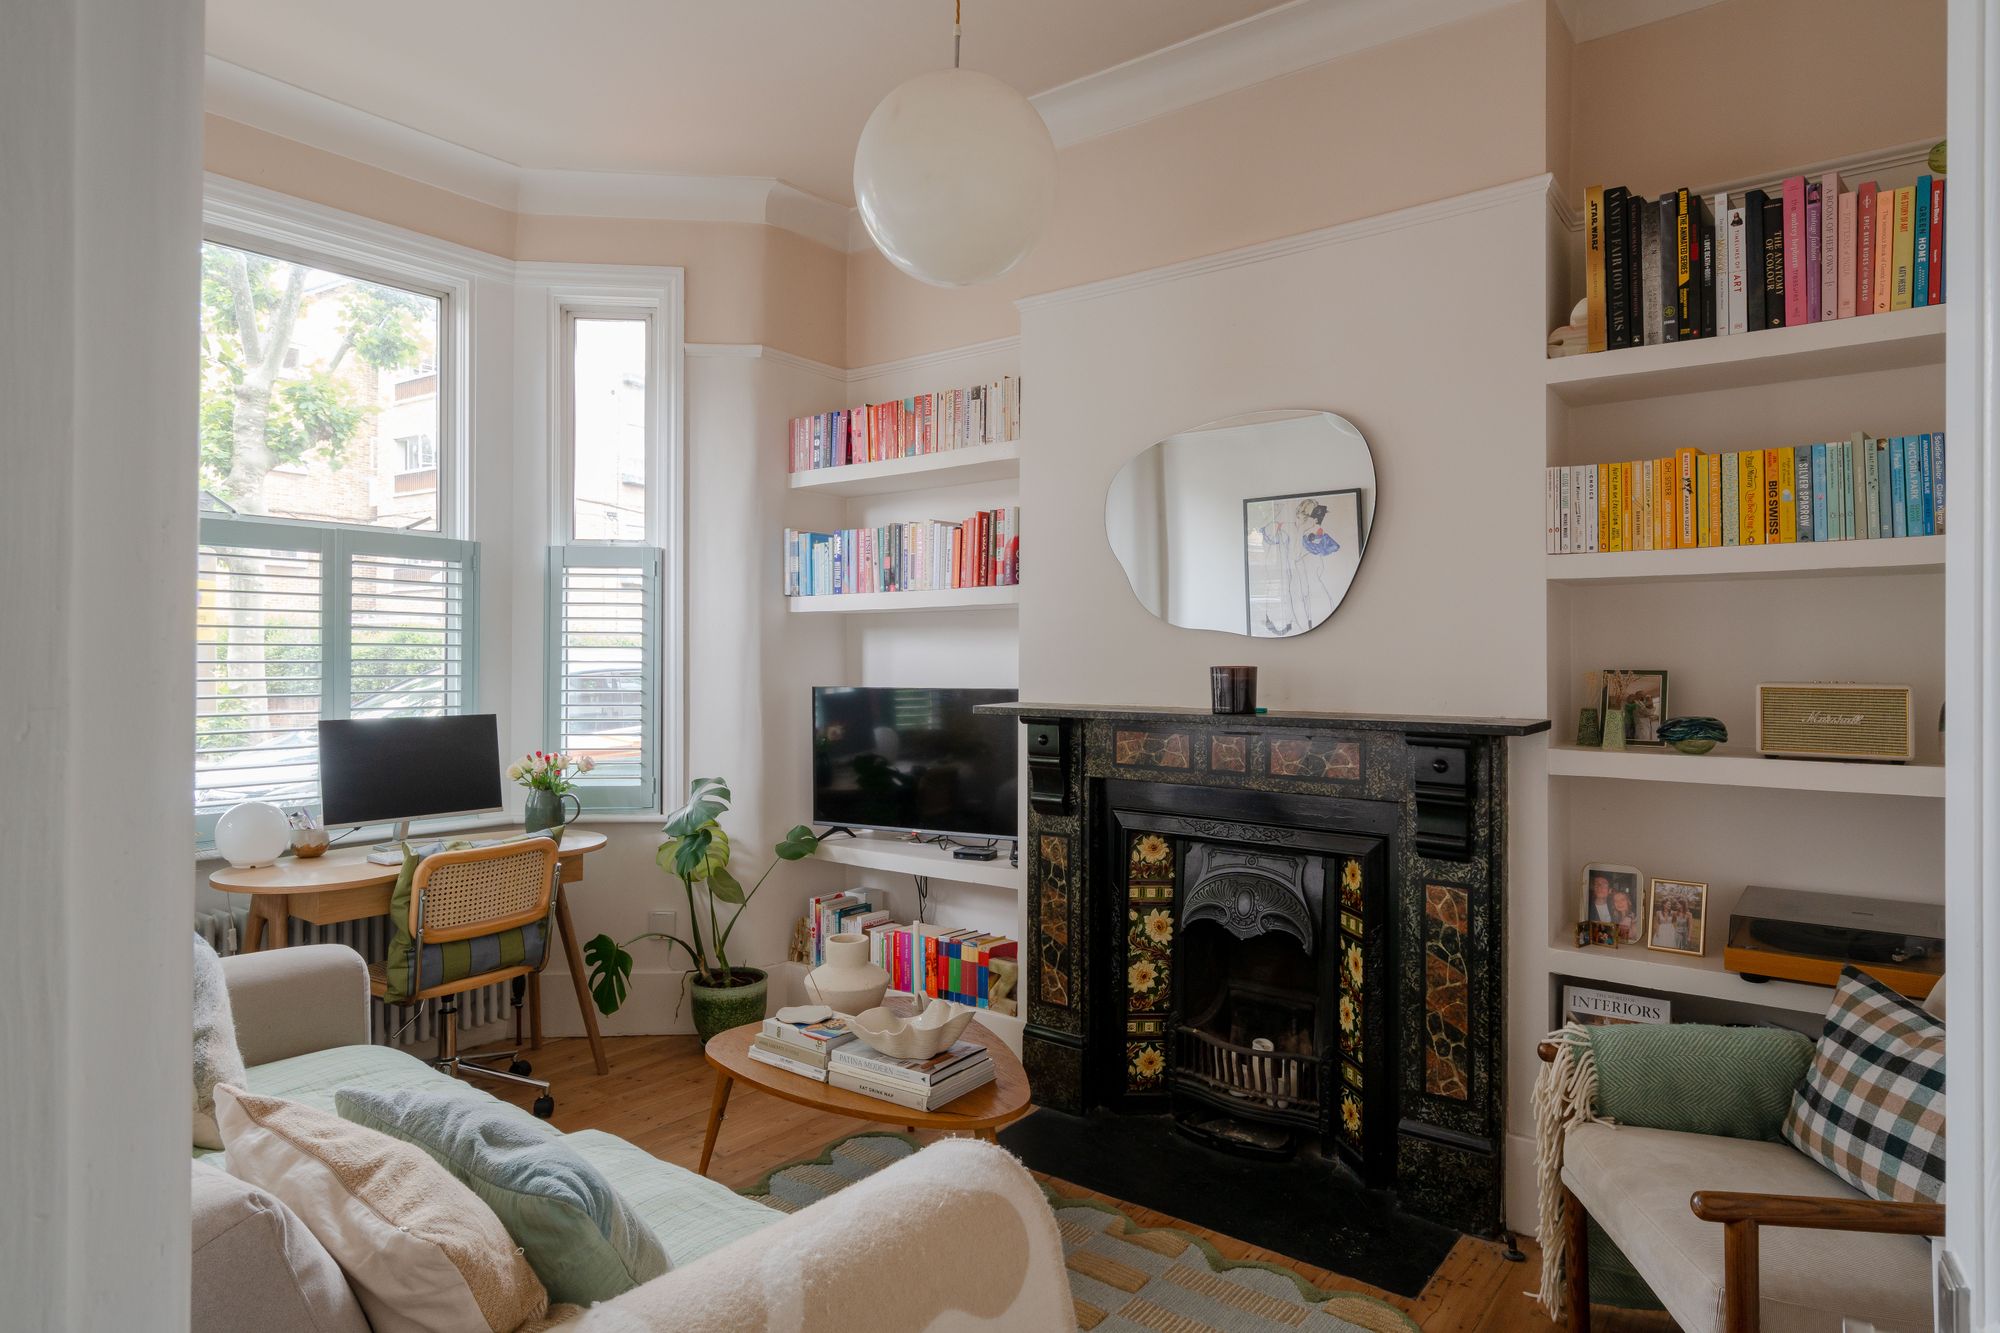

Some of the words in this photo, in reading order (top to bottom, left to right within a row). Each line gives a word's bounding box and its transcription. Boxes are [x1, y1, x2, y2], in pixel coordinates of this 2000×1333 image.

[1901, 191, 1909, 201] THE
[1590, 200, 1598, 226] STAR
[1610, 190, 1621, 235] VANITY
[1825, 194, 1834, 220] ROOM
[1900, 202, 1909, 216] STORY
[1680, 214, 1688, 226] THE
[1826, 221, 1833, 232] OF
[1900, 223, 1908, 233] ART
[1919, 206, 1927, 235] GREEN
[1591, 226, 1599, 252] WARS
[1680, 226, 1688, 255] ANIMATED
[1765, 238, 1773, 250] OF
[1774, 230, 1782, 250] THE
[1826, 234, 1834, 252] HER
[1611, 239, 1622, 266] FAIR
[1790, 239, 1799, 268] hepburn
[1918, 237, 1927, 263] HOME
[1681, 255, 1689, 275] SERIES
[1735, 261, 1740, 269] OF
[1766, 252, 1775, 291] COLOUR
[1775, 252, 1784, 296] ANATOMY
[1826, 254, 1834, 275] OWN
[1898, 265, 1906, 278] KATY
[1612, 268, 1623, 290] 100
[1733, 274, 1742, 293] ART
[1791, 269, 1799, 302] treasures
[1897, 279, 1905, 296] HESSEL
[1612, 292, 1624, 332] YEARS
[924, 397, 932, 415] Kala
[1934, 435, 1942, 459] Soldier
[1747, 455, 1755, 468] Paul
[1908, 441, 1917, 478] VICTORIA
[1935, 460, 1943, 479] Sailor
[1747, 469, 1755, 488] Murray
[1798, 463, 1809, 489] SILVER
[1768, 480, 1778, 498] BIG
[1910, 479, 1918, 499] PARK
[1936, 483, 1944, 504] Claire
[1769, 499, 1778, 535] SWISS
[1799, 491, 1810, 527] SPARROW
[1936, 505, 1944, 524] Kilroy
[1801, 711, 1864, 726] Marshall
[1573, 995, 1660, 1019] INTERIORS
[839, 1053, 863, 1068] PATINA
[863, 1060, 894, 1076] MODERN
[869, 1086, 883, 1095] DRINK
